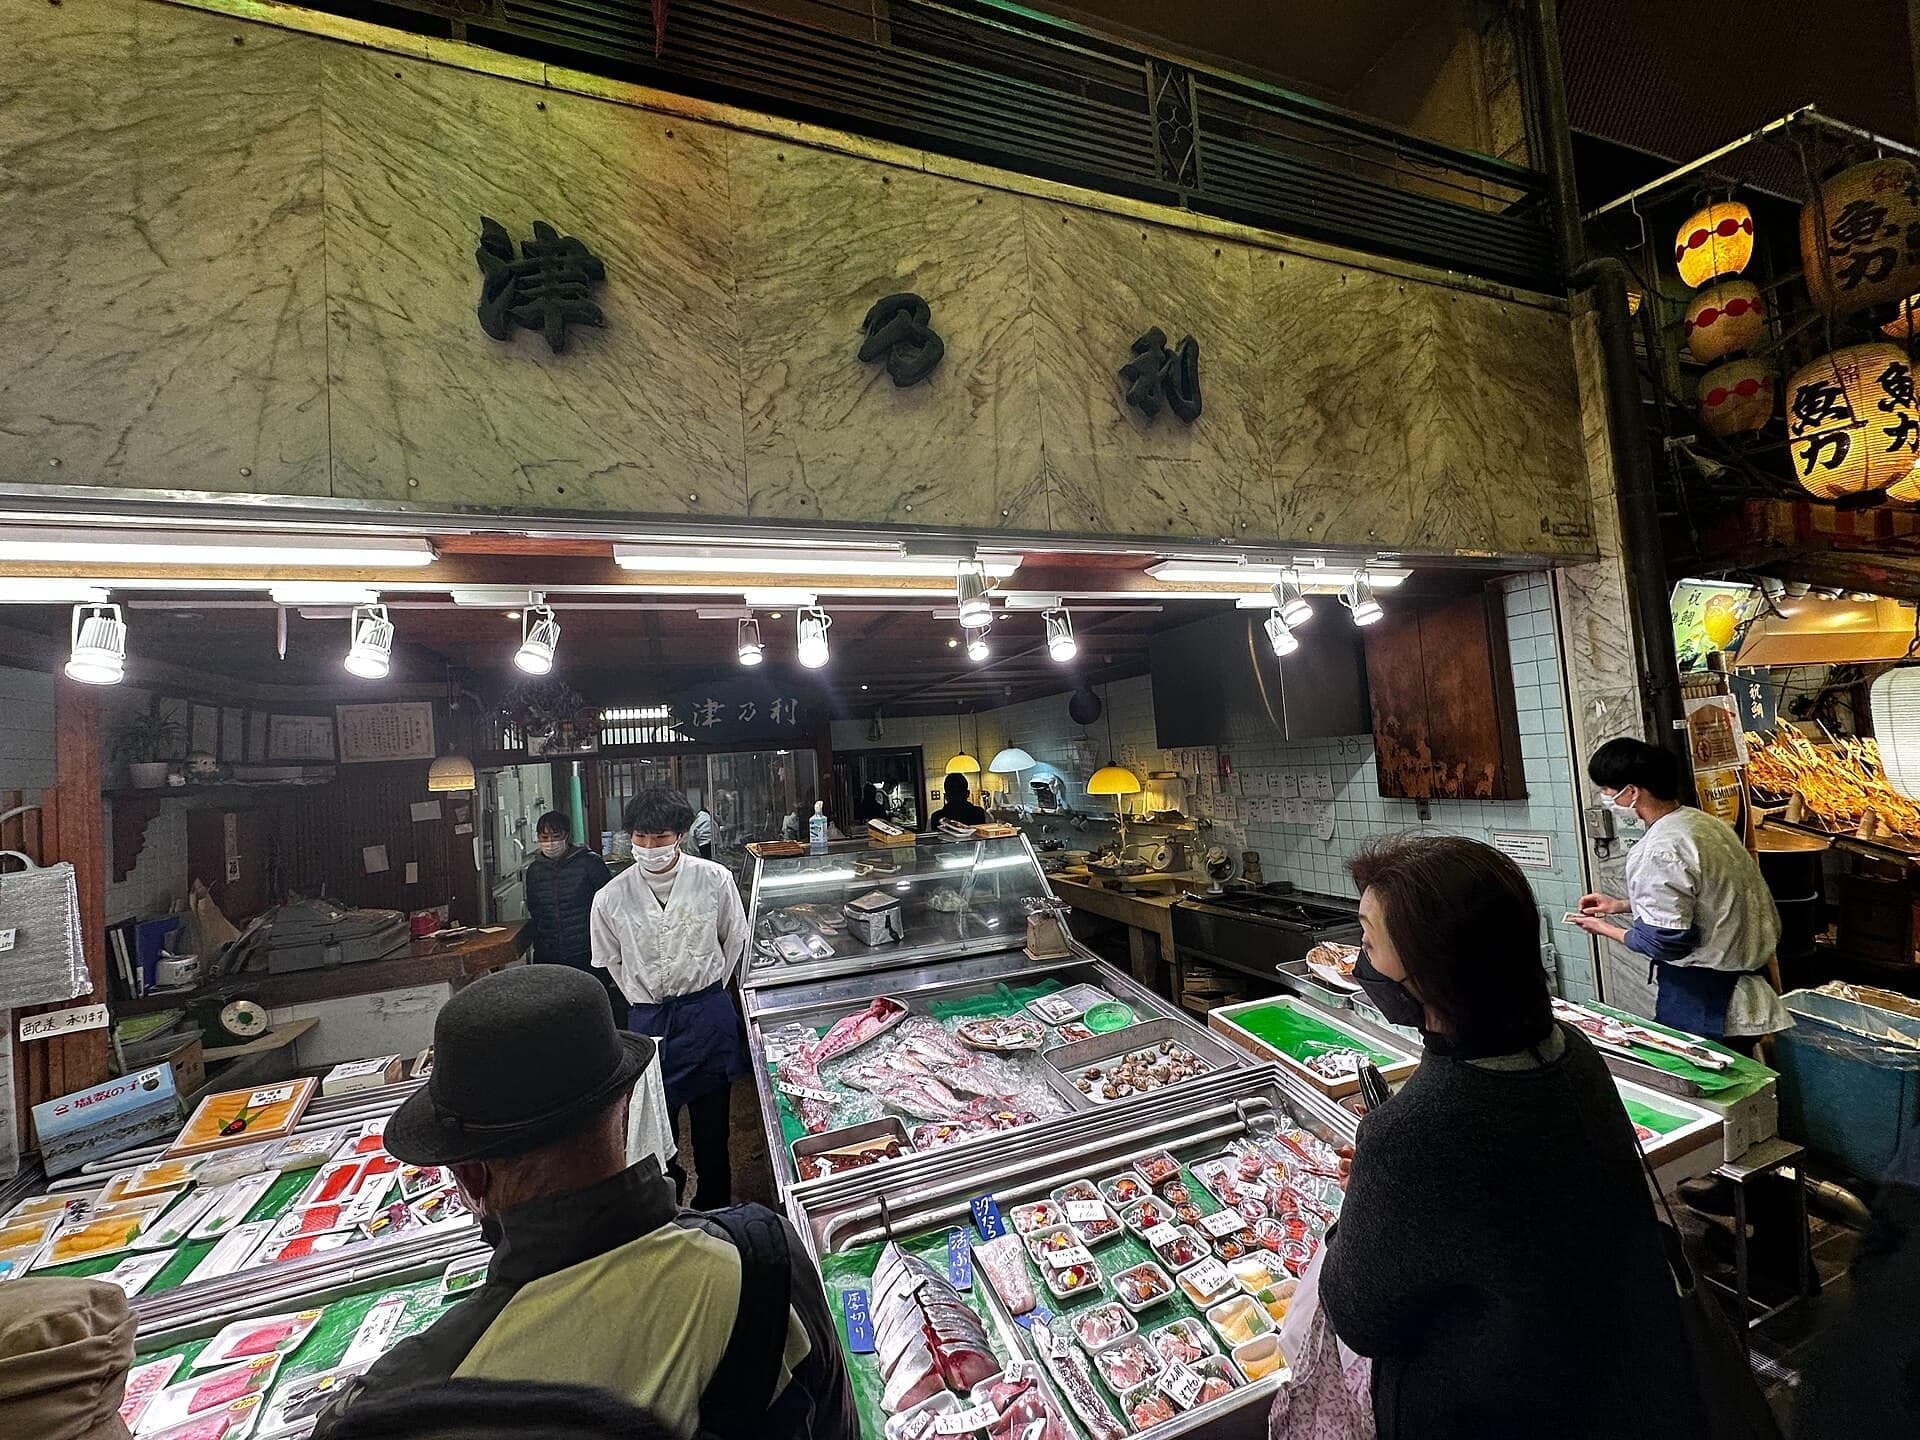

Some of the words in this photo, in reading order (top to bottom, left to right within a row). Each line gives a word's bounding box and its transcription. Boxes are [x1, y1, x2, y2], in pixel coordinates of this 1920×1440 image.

[692, 697, 799, 728] 津乃利
[1704, 785, 1738, 802] PREMIUM
[23, 1016, 61, 1036] 配送
[66, 1010, 104, 1026] 承ります
[847, 1292, 866, 1339] 厚切り
